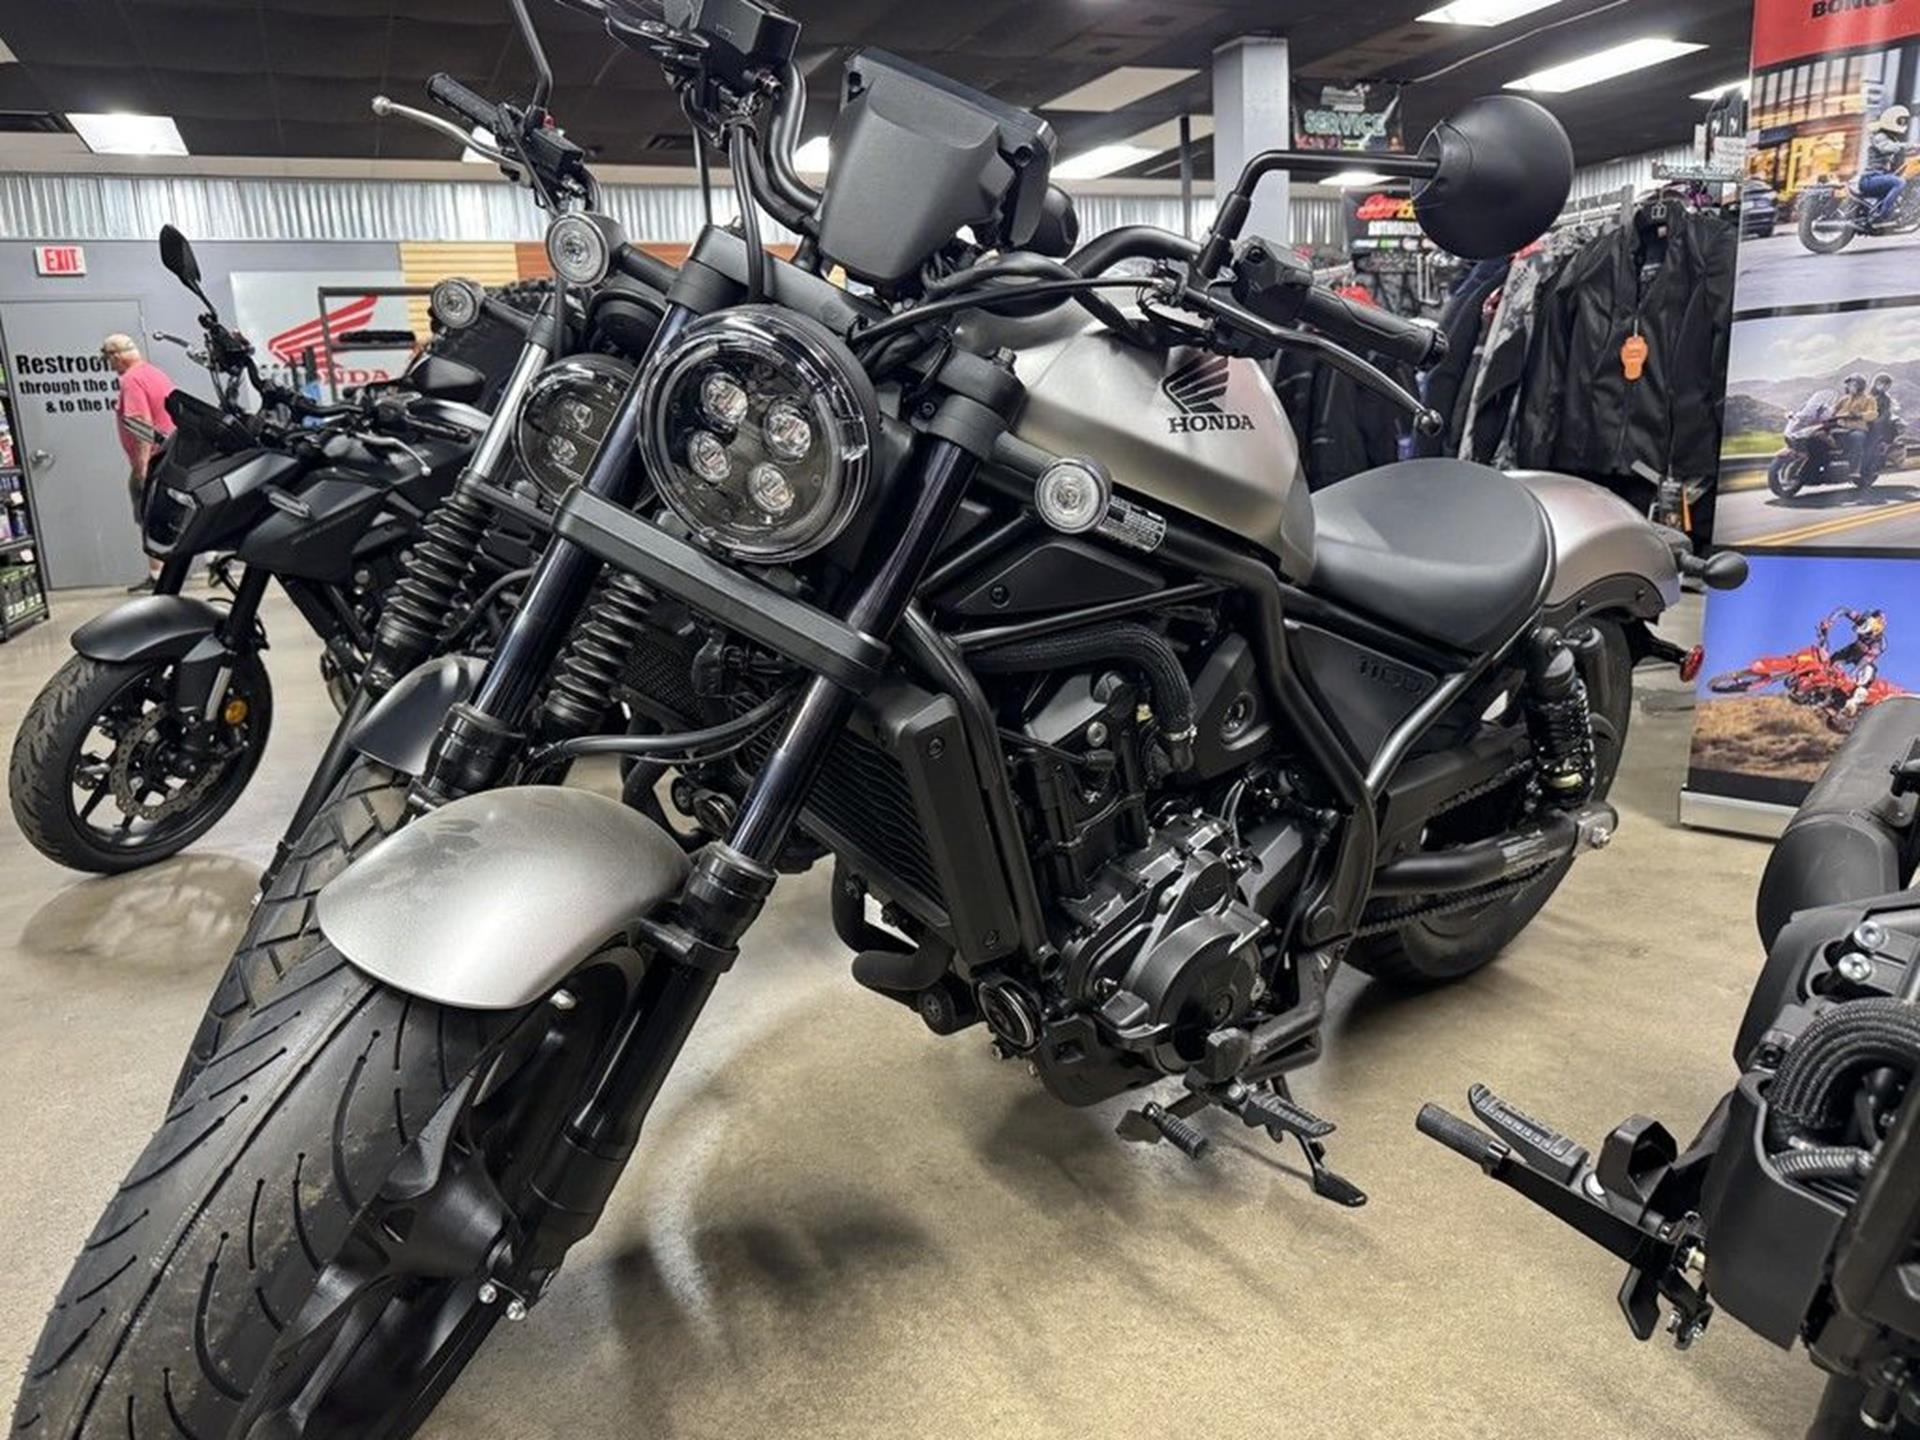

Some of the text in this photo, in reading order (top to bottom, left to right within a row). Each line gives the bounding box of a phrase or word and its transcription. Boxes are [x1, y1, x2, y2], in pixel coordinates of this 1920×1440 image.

[1304, 109, 1387, 136] SERVICE
[44, 249, 77, 271] EXIT
[19, 380, 80, 395] through
[83, 379, 107, 393] the
[46, 402, 57, 414] &
[60, 401, 74, 413] to
[78, 398, 103, 412] the
[1168, 414, 1256, 434] HONDA
